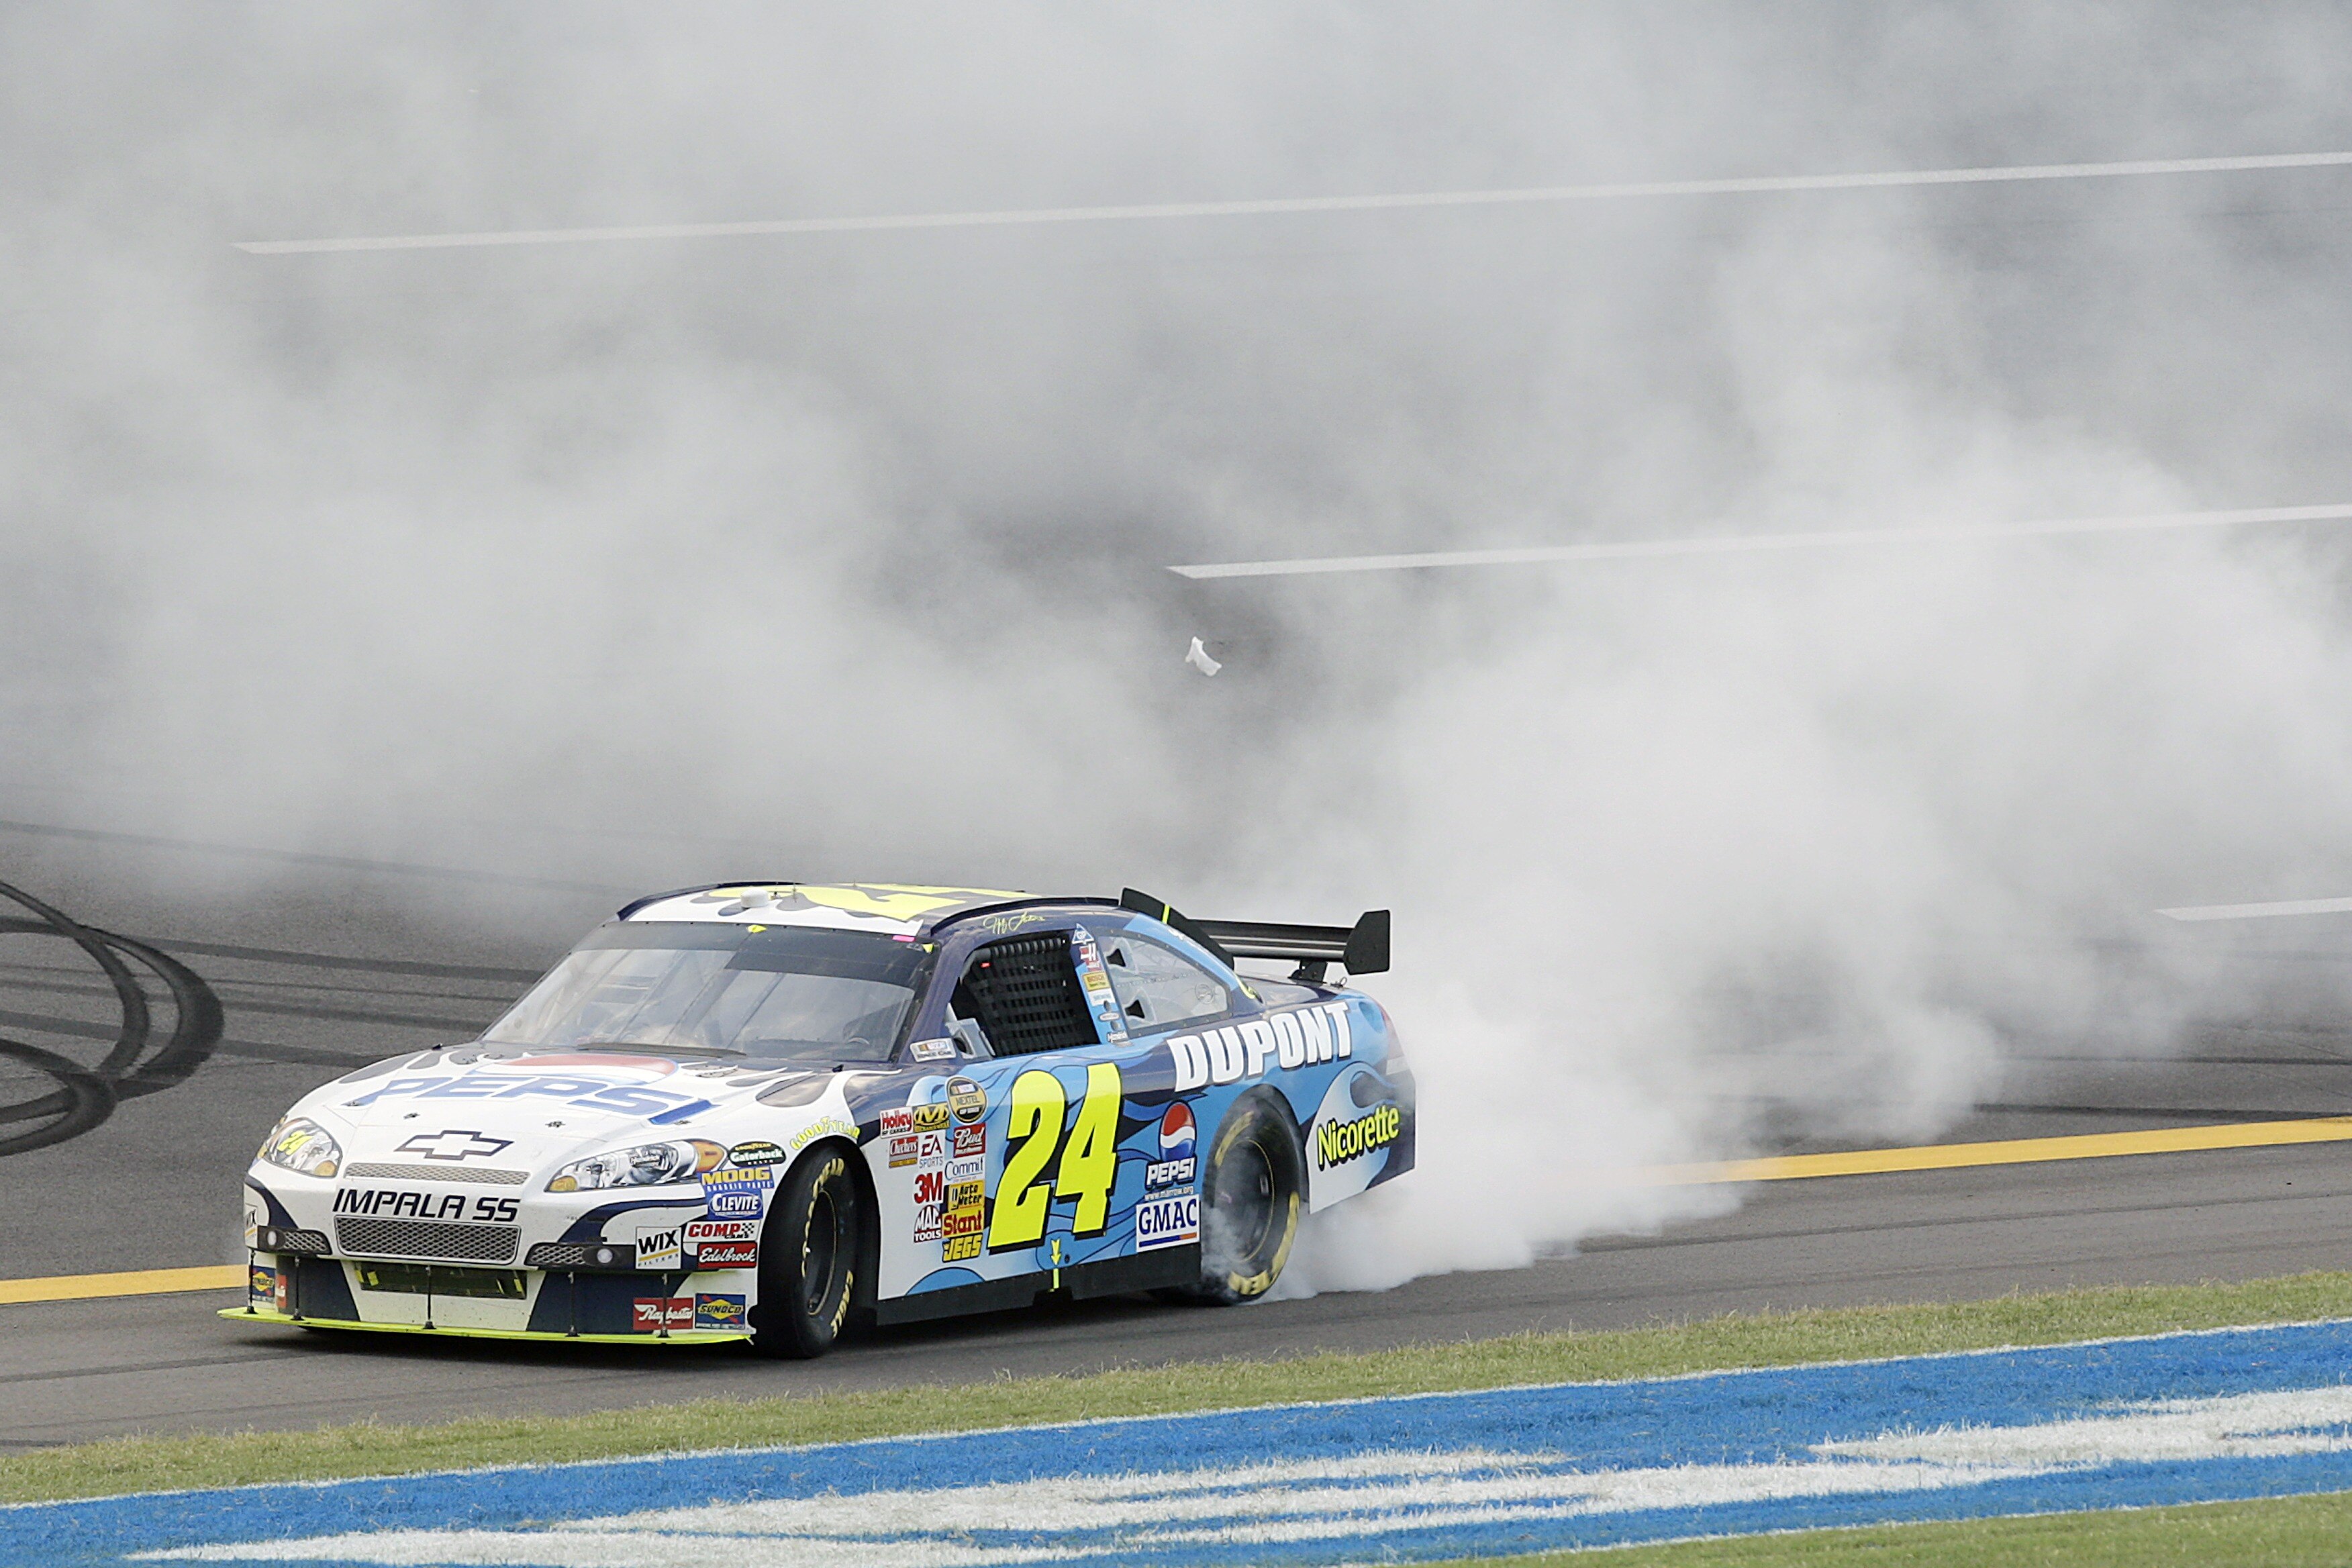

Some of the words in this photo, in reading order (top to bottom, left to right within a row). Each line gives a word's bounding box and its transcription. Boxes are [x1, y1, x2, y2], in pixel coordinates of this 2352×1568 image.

[1167, 1001, 1351, 1092] DUPONT
[342, 1077, 722, 1126] PEPSI
[955, 1095, 980, 1106] NEXTEL
[790, 1116, 860, 1150] GOODYEAR
[881, 1110, 912, 1131] Holley
[277, 1130, 313, 1155] 24
[921, 1134, 942, 1157] EA
[954, 1127, 985, 1148] Bud
[1318, 1105, 1400, 1166] Nicorette
[730, 1148, 783, 1163] Gatorback
[919, 1157, 944, 1169] SPORTS
[987, 1062, 1121, 1247] 24
[701, 1167, 771, 1185] MOOG
[945, 1157, 983, 1181] Commit
[1146, 1157, 1195, 1186] PEPSI
[914, 1171, 943, 1204] 3M
[332, 1188, 466, 1219] IMPALA
[472, 1197, 520, 1222] SS
[712, 1193, 759, 1212] CLEVITE
[915, 1206, 941, 1232] MAC
[943, 1210, 983, 1236] Stant
[1138, 1198, 1197, 1235] GMAC
[638, 1229, 679, 1255] WIX
[688, 1223, 741, 1238] COMP
[915, 1230, 942, 1242] TOOLS
[699, 1246, 756, 1263] Edelbrock
[943, 1234, 983, 1262] JEGS
[699, 1305, 742, 1314] SUNOCO
